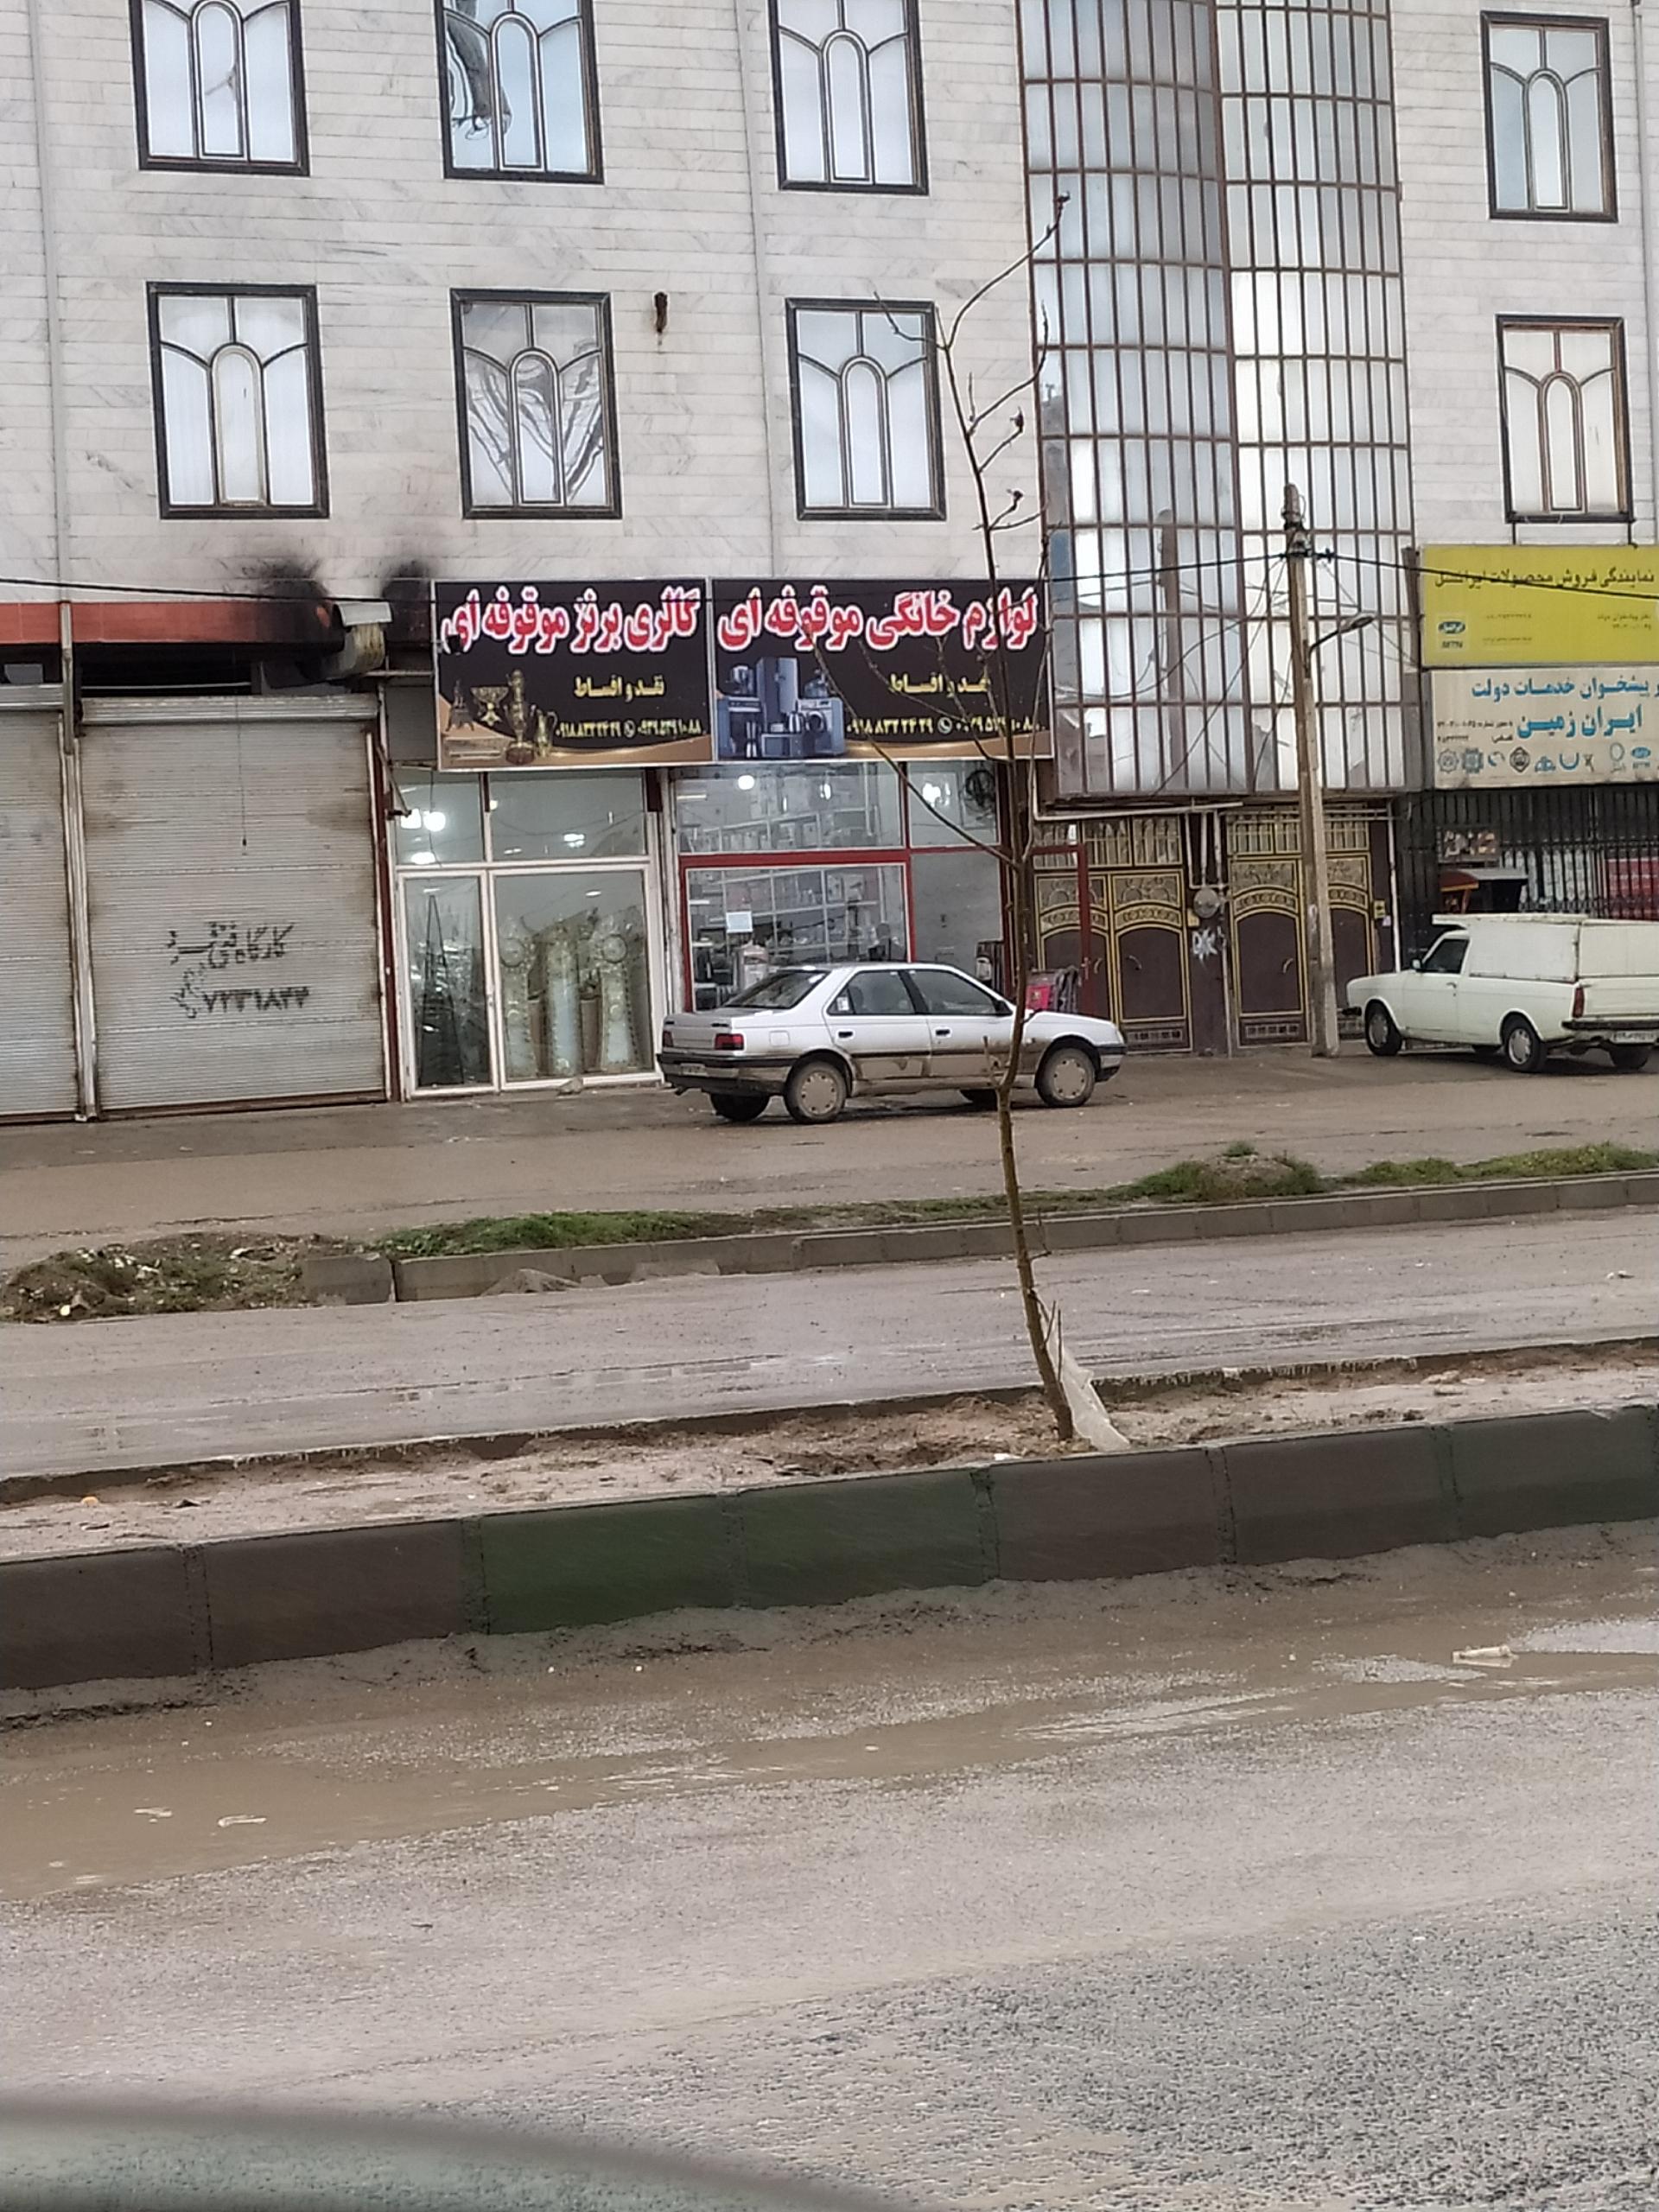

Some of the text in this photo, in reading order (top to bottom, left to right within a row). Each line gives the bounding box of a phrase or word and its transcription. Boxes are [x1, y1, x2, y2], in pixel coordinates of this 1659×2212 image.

[1556, 569, 1598, 589] فروش
[481, 585, 570, 654] موقوفه
[569, 588, 623, 653] برنز
[717, 586, 1039, 651] لوازم خانگی موقوفه ای
[574, 674, 666, 702] نقد و اقساط
[1471, 678, 1510, 702] دولت
[1514, 677, 1575, 696] خدمات
[1516, 703, 1643, 739] ایران زمین
